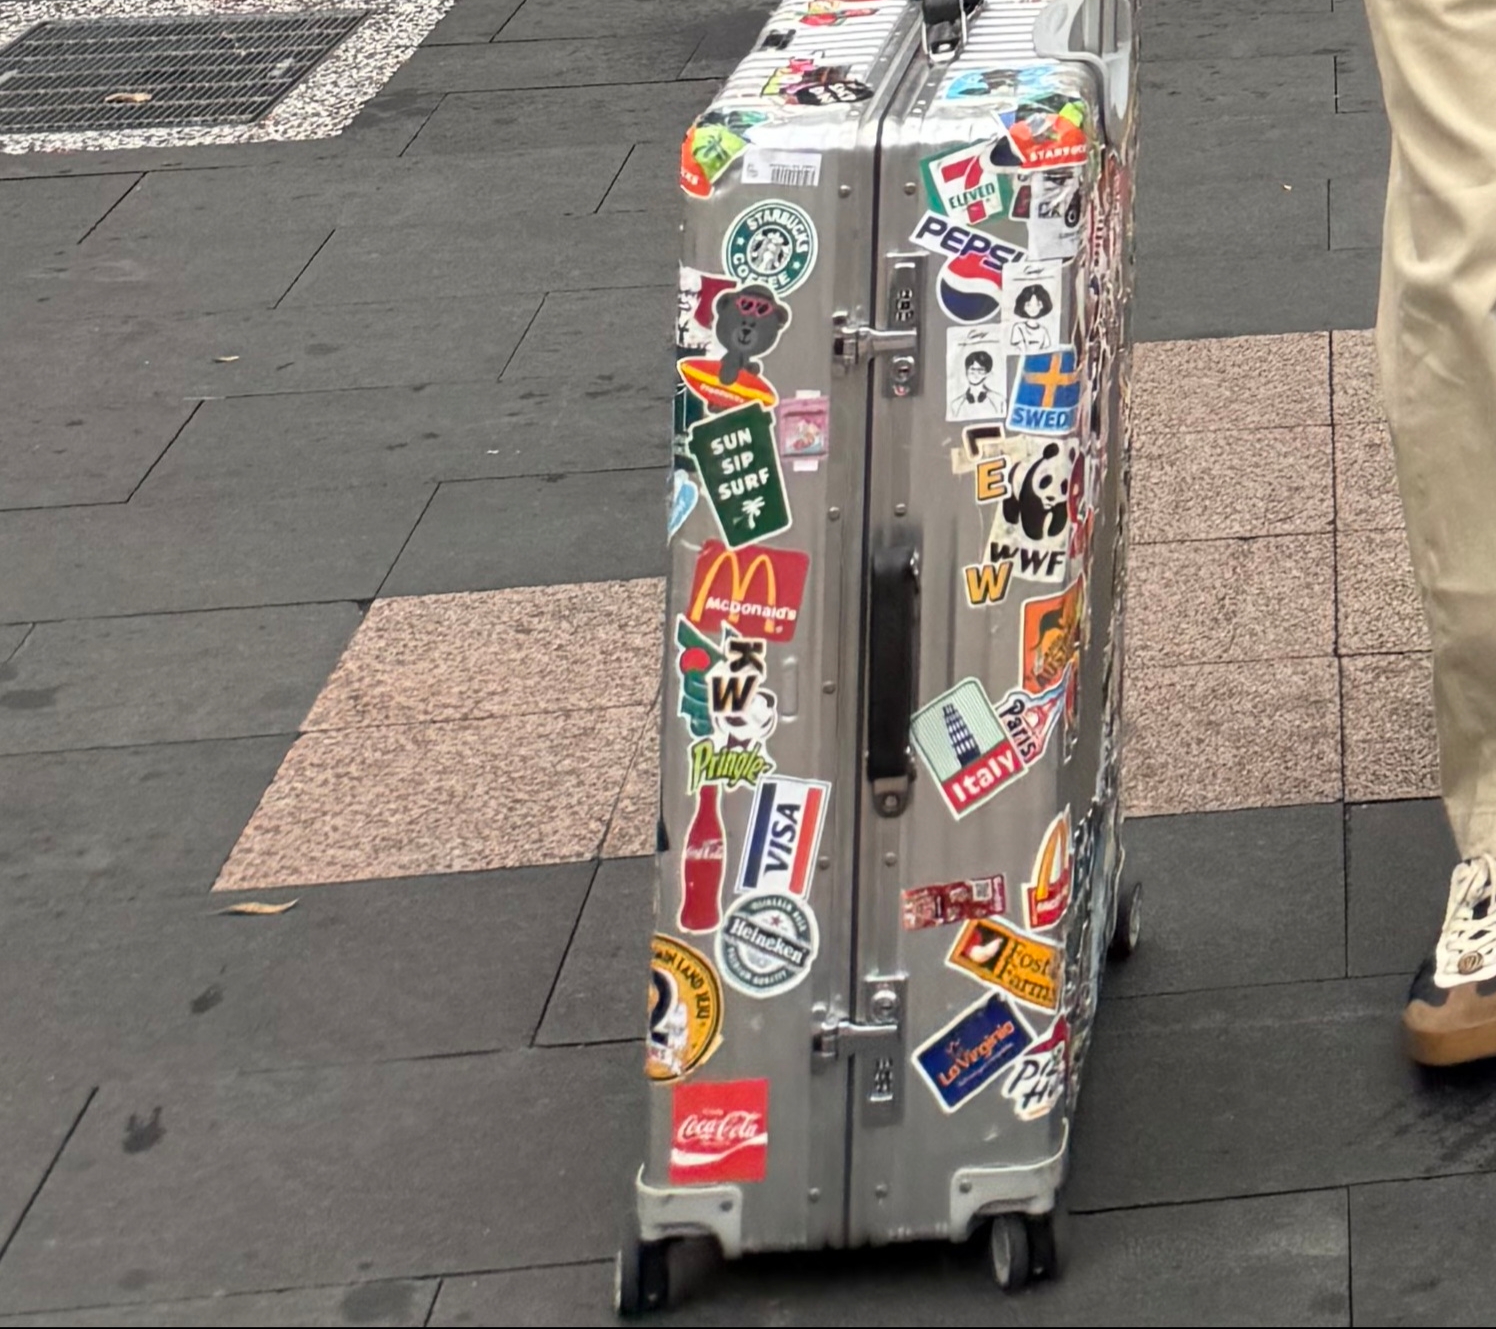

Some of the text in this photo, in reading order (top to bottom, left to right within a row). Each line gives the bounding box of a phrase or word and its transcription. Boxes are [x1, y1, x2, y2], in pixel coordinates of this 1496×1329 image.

[746, 208, 810, 254] STARBUCKS
[711, 427, 752, 455] SUN
[721, 451, 754, 475] SIP
[718, 467, 770, 501] SURF
[705, 596, 797, 621] McDonald's
[999, 698, 1036, 758] Paris
[951, 748, 1015, 803] Italy
[764, 802, 802, 877] VISA
[730, 917, 805, 963] Heineken
[677, 1109, 762, 1142] Coca-Cola
